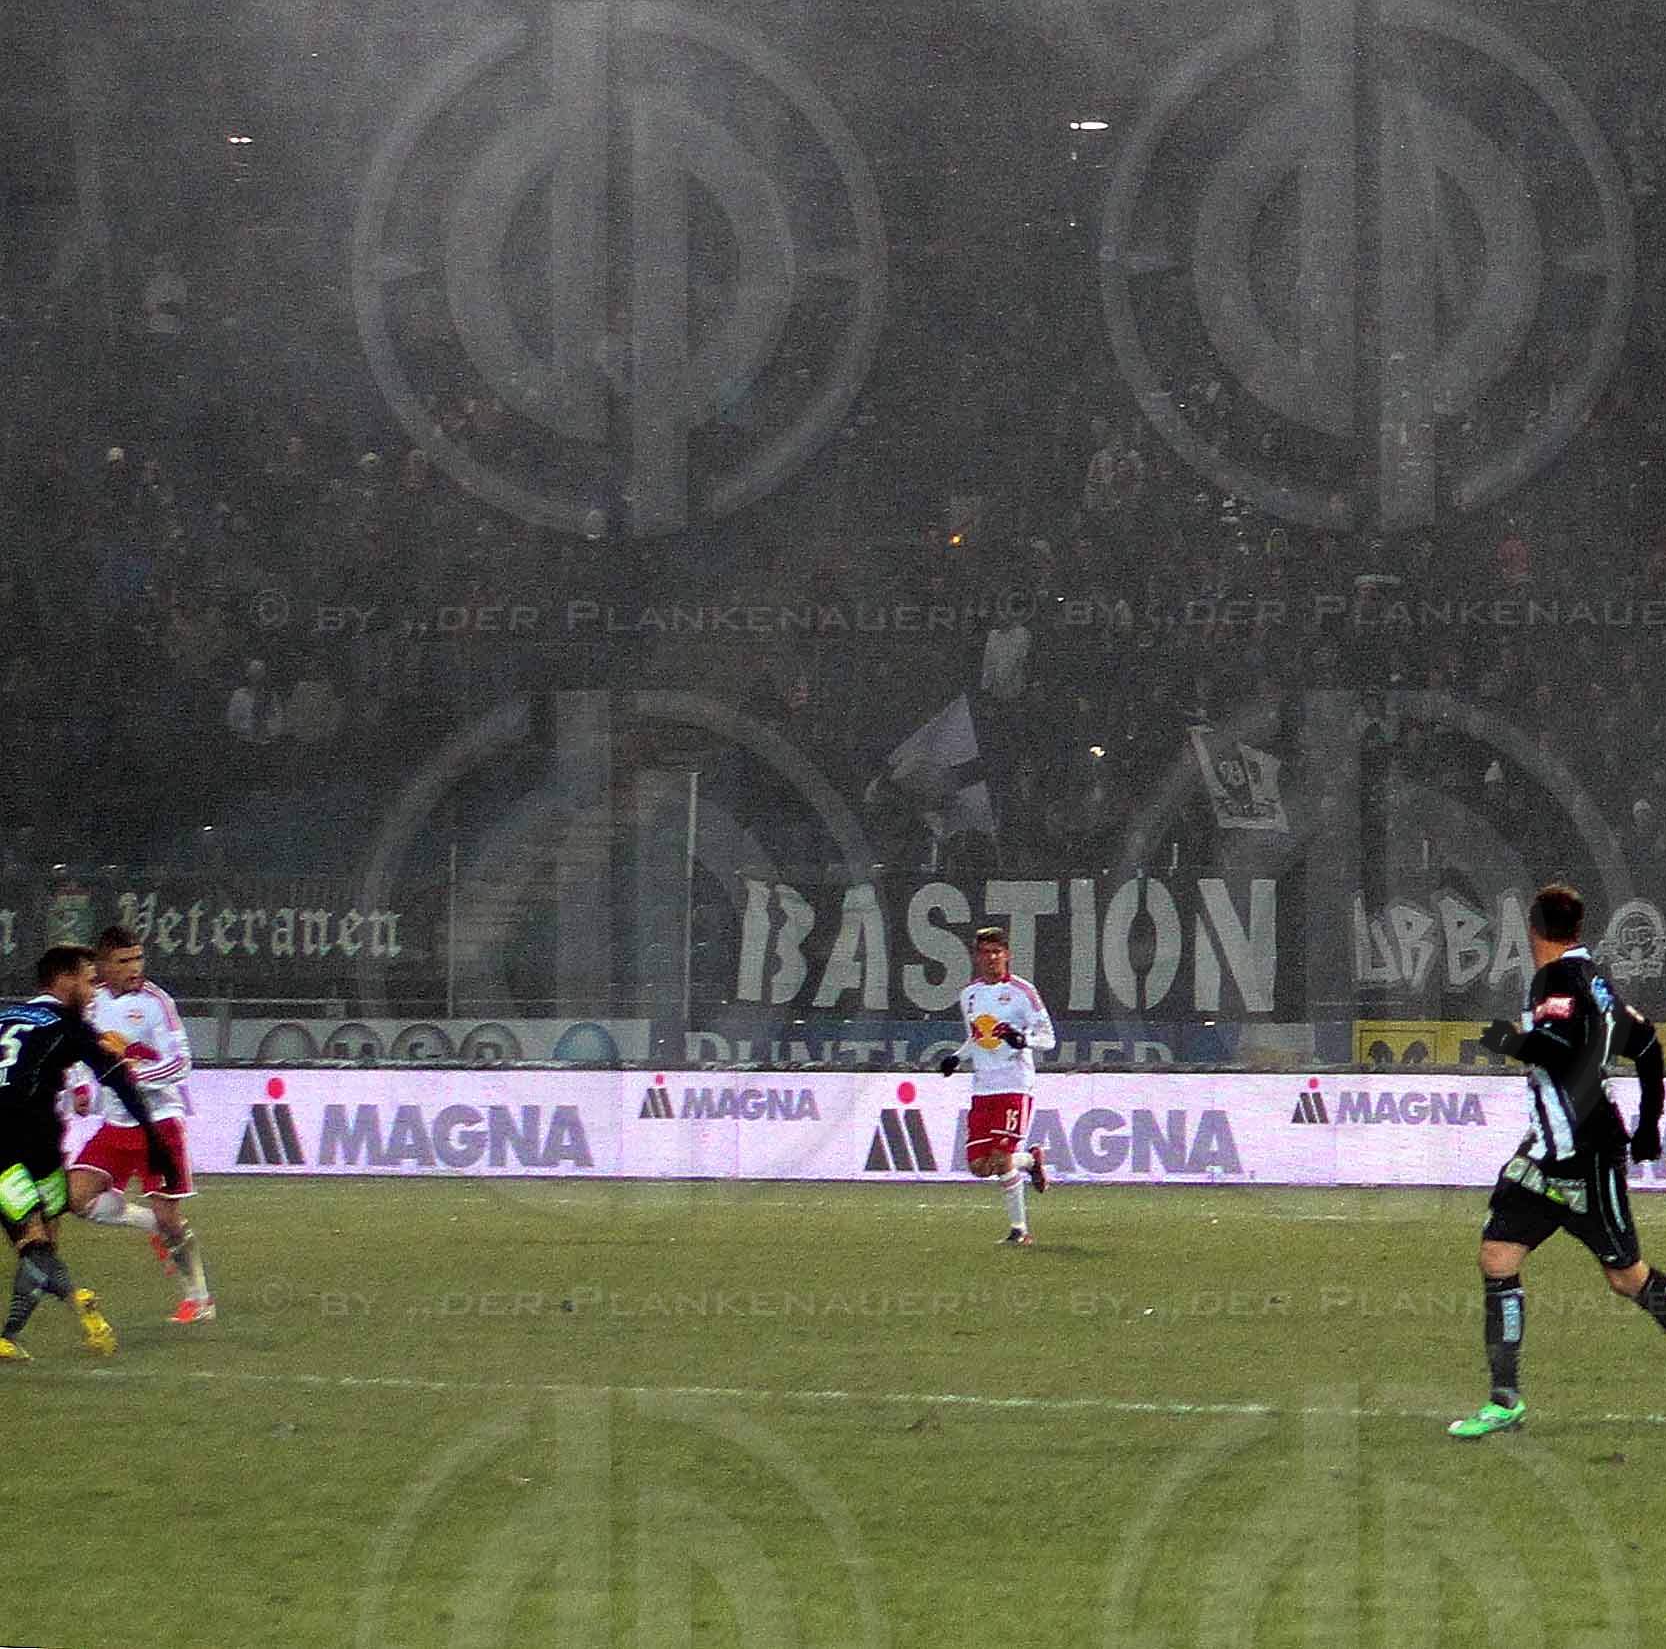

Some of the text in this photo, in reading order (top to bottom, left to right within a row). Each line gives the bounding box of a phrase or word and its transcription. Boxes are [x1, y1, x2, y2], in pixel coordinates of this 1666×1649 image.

[117, 891, 403, 958] Veteranen
[735, 874, 1278, 1015] BASTION
[1350, 883, 1536, 988] URBA
[318, 1103, 595, 1168] MAGNA
[680, 1086, 819, 1122] MAGNA
[1336, 1090, 1488, 1127] MAGNA
